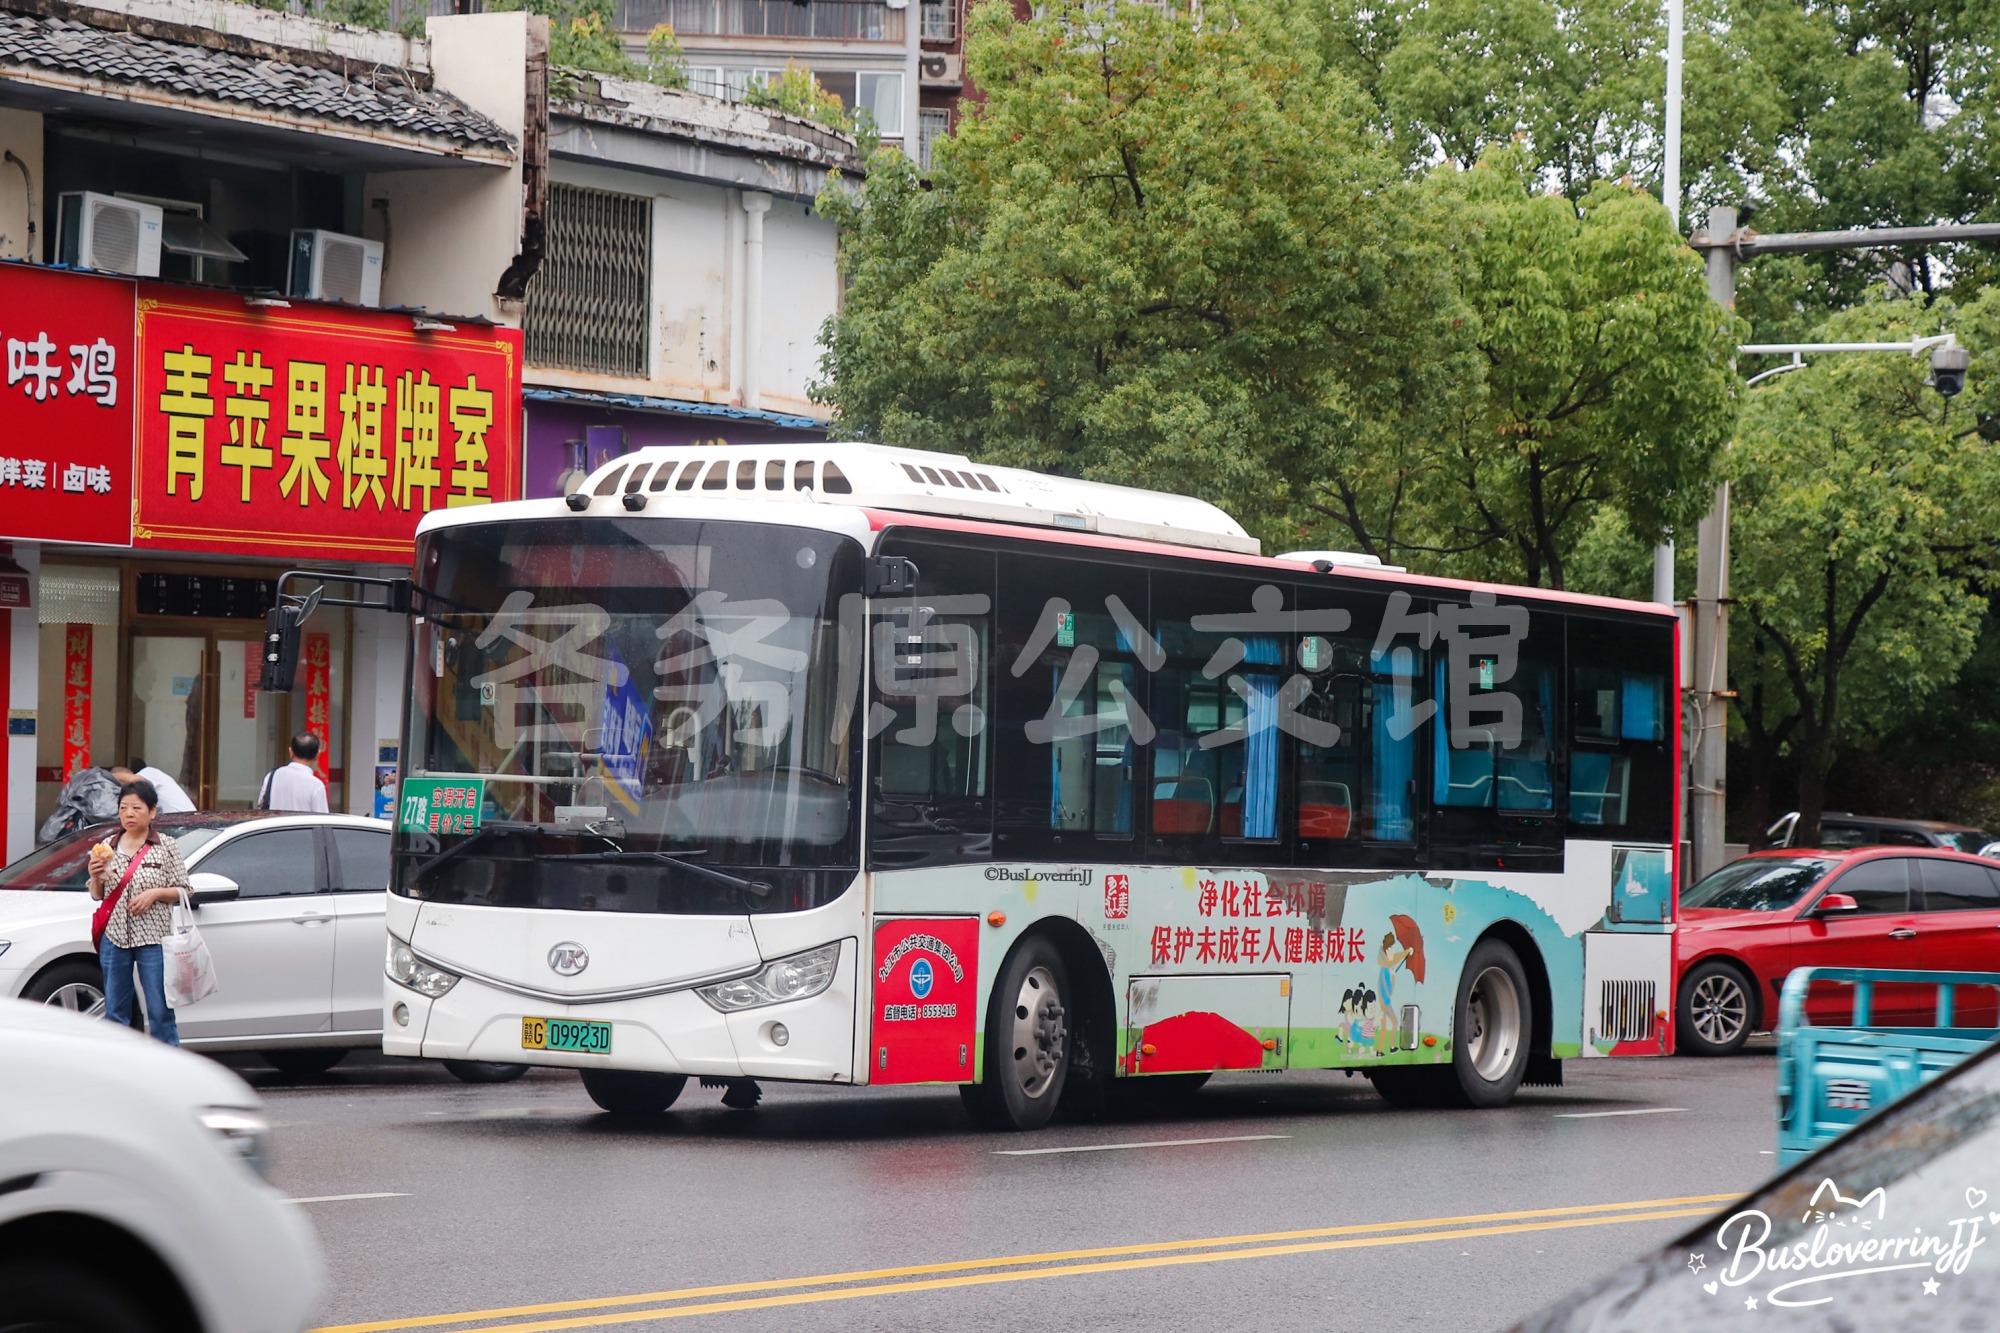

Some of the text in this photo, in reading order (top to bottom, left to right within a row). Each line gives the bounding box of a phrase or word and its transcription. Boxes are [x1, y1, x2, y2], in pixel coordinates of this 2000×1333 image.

[0, 331, 118, 407] 味鸡
[160, 344, 493, 512] 青苹果棋牌室
[63, 462, 111, 493] 卤味
[404, 796, 428, 825] 27路
[431, 787, 477, 808] 空调开启
[428, 813, 475, 835] 票价2元
[1198, 879, 1327, 919] 净化社会环境
[879, 933, 964, 983] 九江市公共交通集团公司
[1150, 925, 1366, 965] 保护未成年人健康成长
